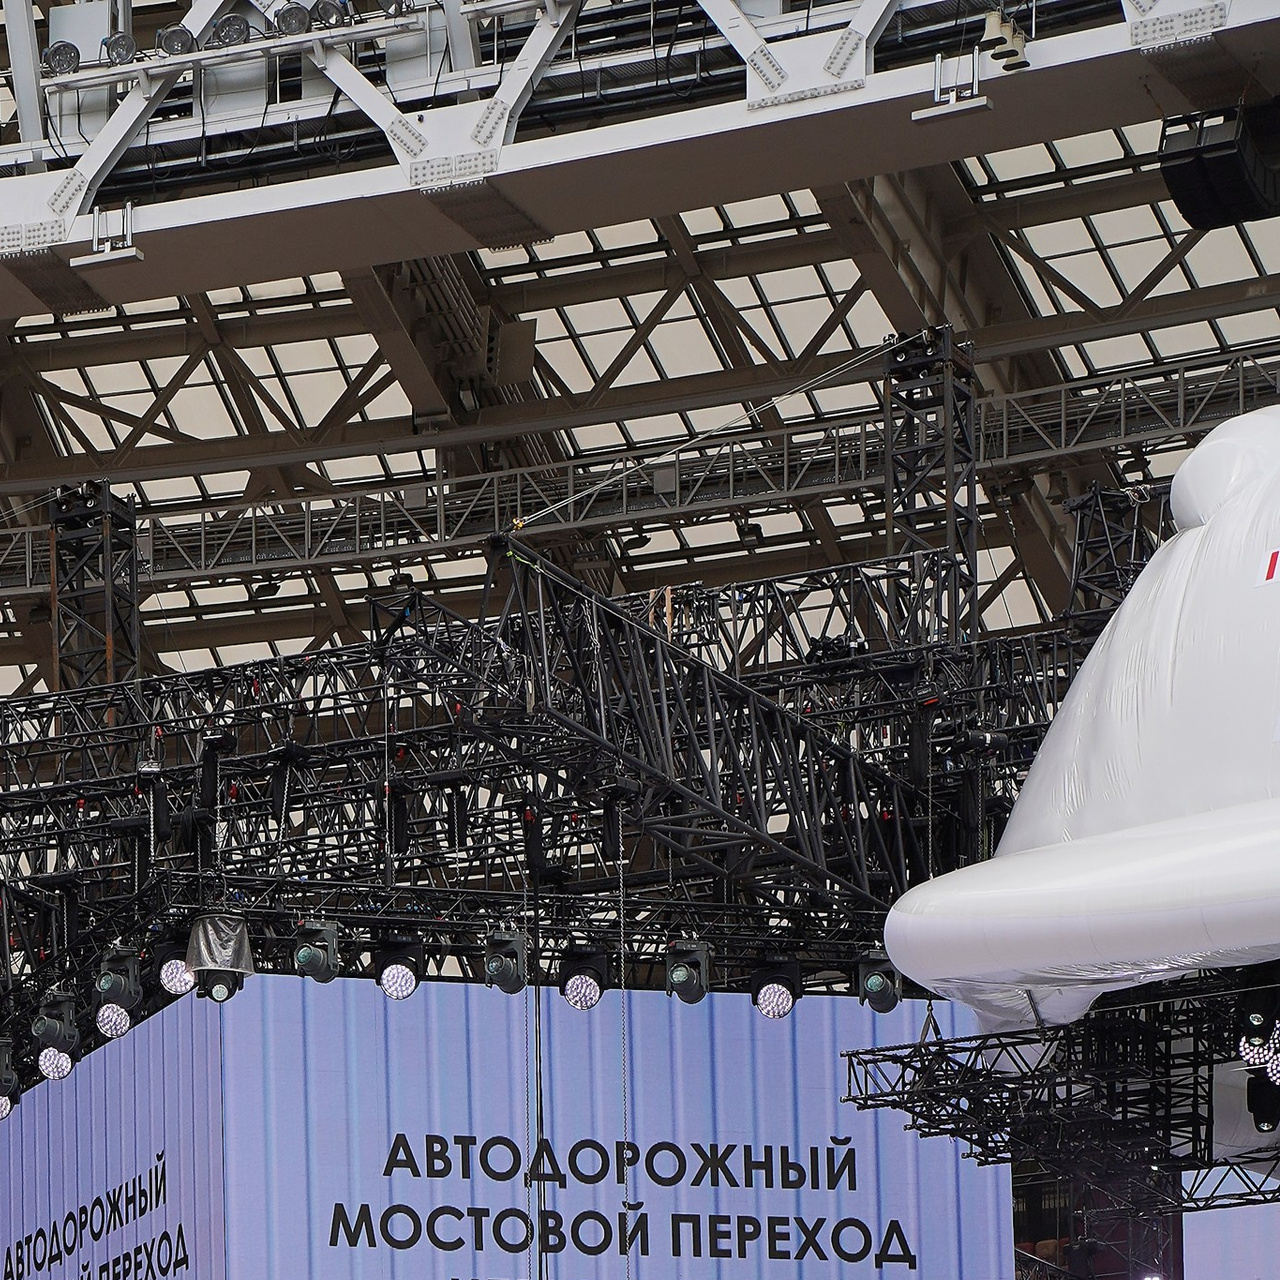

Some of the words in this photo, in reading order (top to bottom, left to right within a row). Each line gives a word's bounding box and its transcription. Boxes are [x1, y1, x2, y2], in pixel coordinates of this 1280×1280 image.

[383, 1133, 857, 1191] АВТОДОРОЖНЫЙ
[329, 1202, 649, 1256] МОСТОВОЙ
[671, 1213, 917, 1270] ПЕРЕХОД
